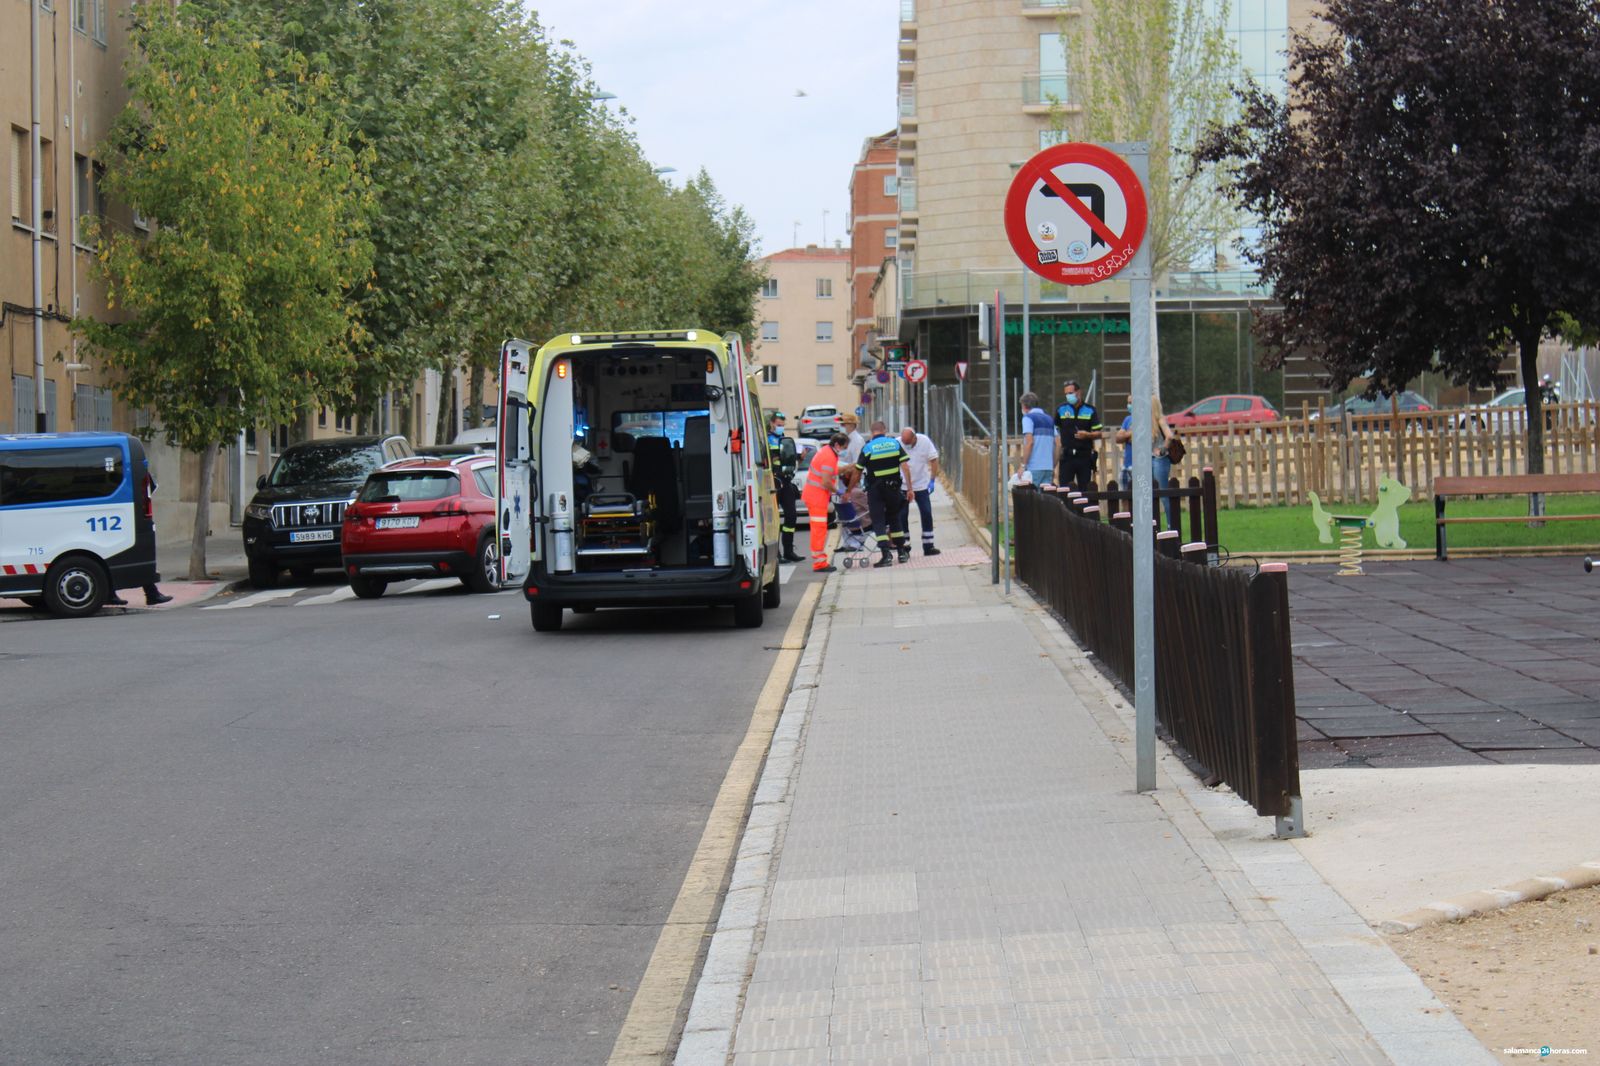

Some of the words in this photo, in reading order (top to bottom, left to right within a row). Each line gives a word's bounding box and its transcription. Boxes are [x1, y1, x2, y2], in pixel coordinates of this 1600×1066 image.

[86, 516, 122, 532] 112
[296, 532, 315, 541] 5989
[318, 531, 332, 540] KHG
[28, 547, 44, 555] 715
